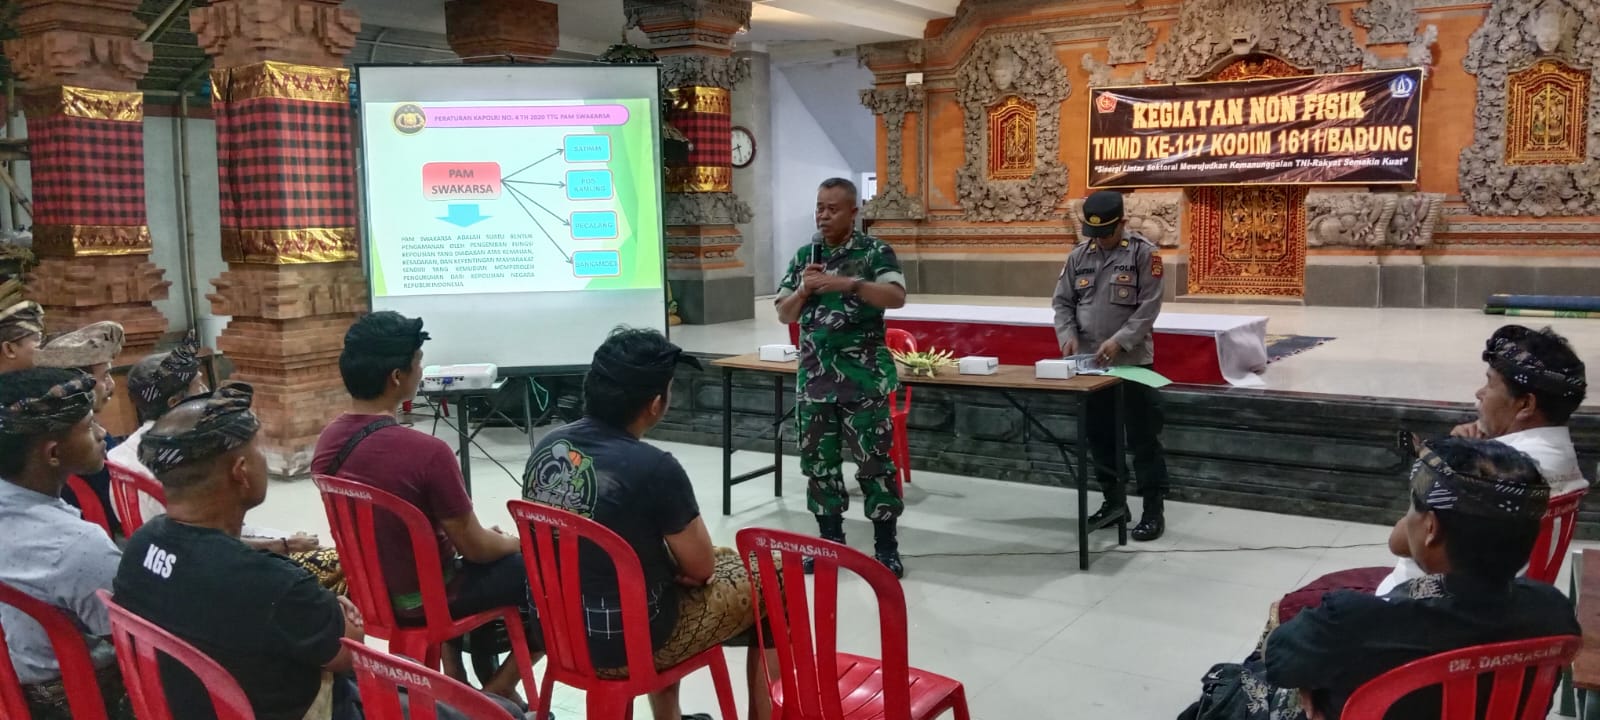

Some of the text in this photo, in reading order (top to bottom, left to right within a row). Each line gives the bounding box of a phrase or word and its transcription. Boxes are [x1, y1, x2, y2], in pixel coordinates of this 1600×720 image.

[1133, 91, 1366, 128] KEGIATAN NON FISIK
[1092, 125, 1414, 160] TMMD KE-117 KODIM 1611/BADUNG
[432, 184, 494, 195] SWAKARSA
[449, 169, 474, 179] PAM
[144, 544, 176, 578] KGS
